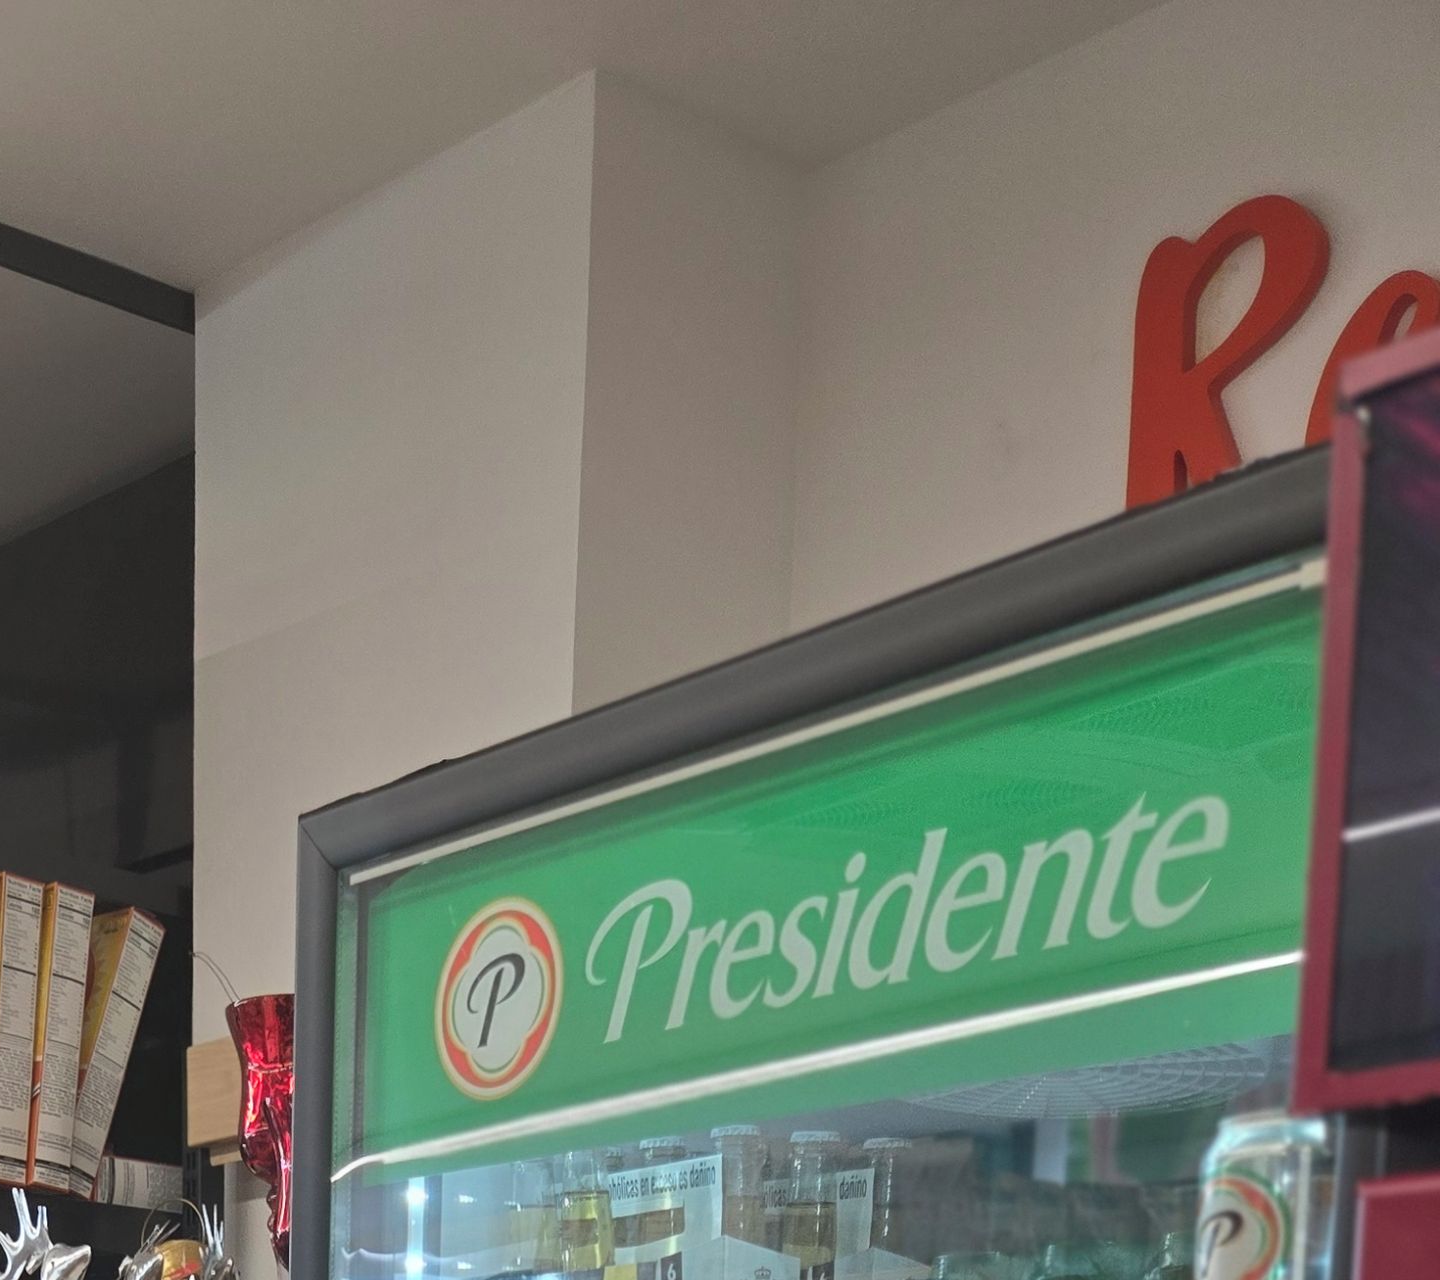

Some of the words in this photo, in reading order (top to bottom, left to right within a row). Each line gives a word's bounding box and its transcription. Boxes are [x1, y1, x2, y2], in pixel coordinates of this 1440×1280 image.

[584, 790, 1230, 1046] Presidente
[640, 1177, 649, 1194] en
[679, 1172, 688, 1189] es
